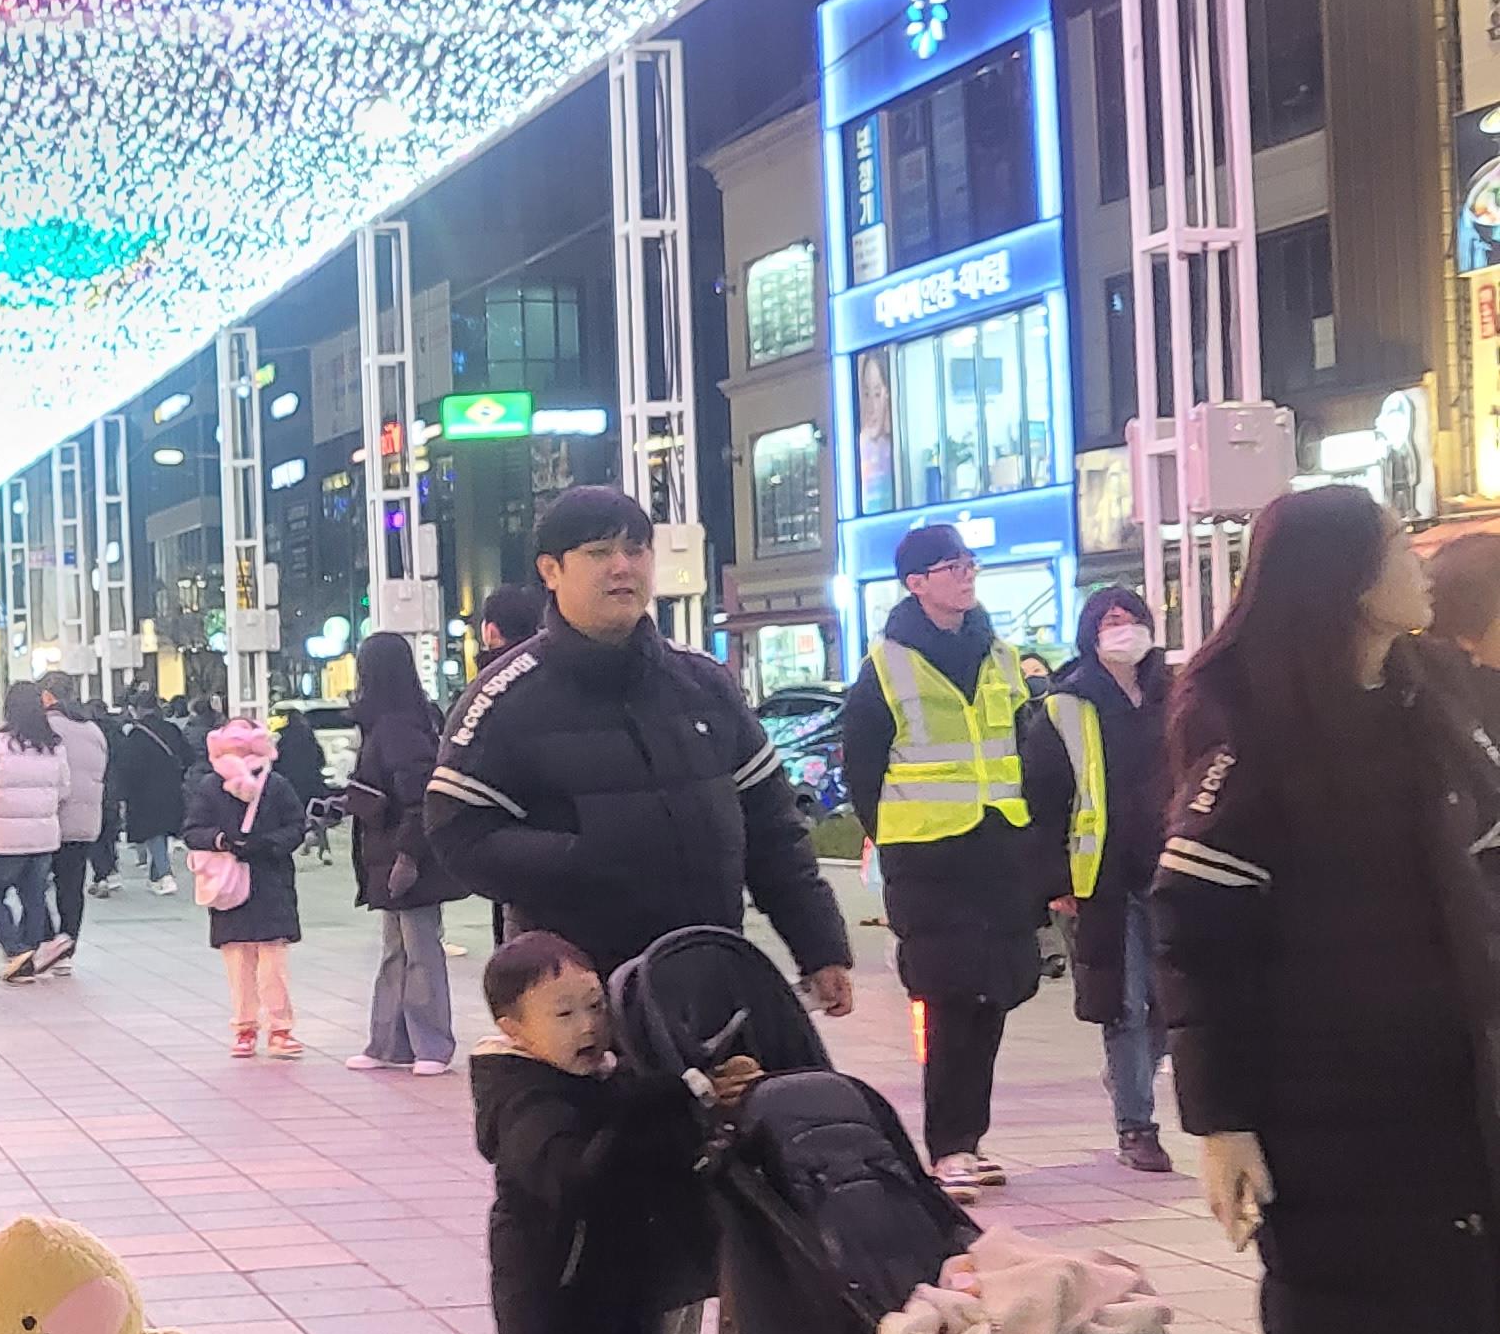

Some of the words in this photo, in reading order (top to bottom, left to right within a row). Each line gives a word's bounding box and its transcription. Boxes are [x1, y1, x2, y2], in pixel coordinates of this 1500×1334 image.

[462, 692, 493, 728] coq
[450, 727, 475, 746] le
[1188, 791, 1216, 814] le
